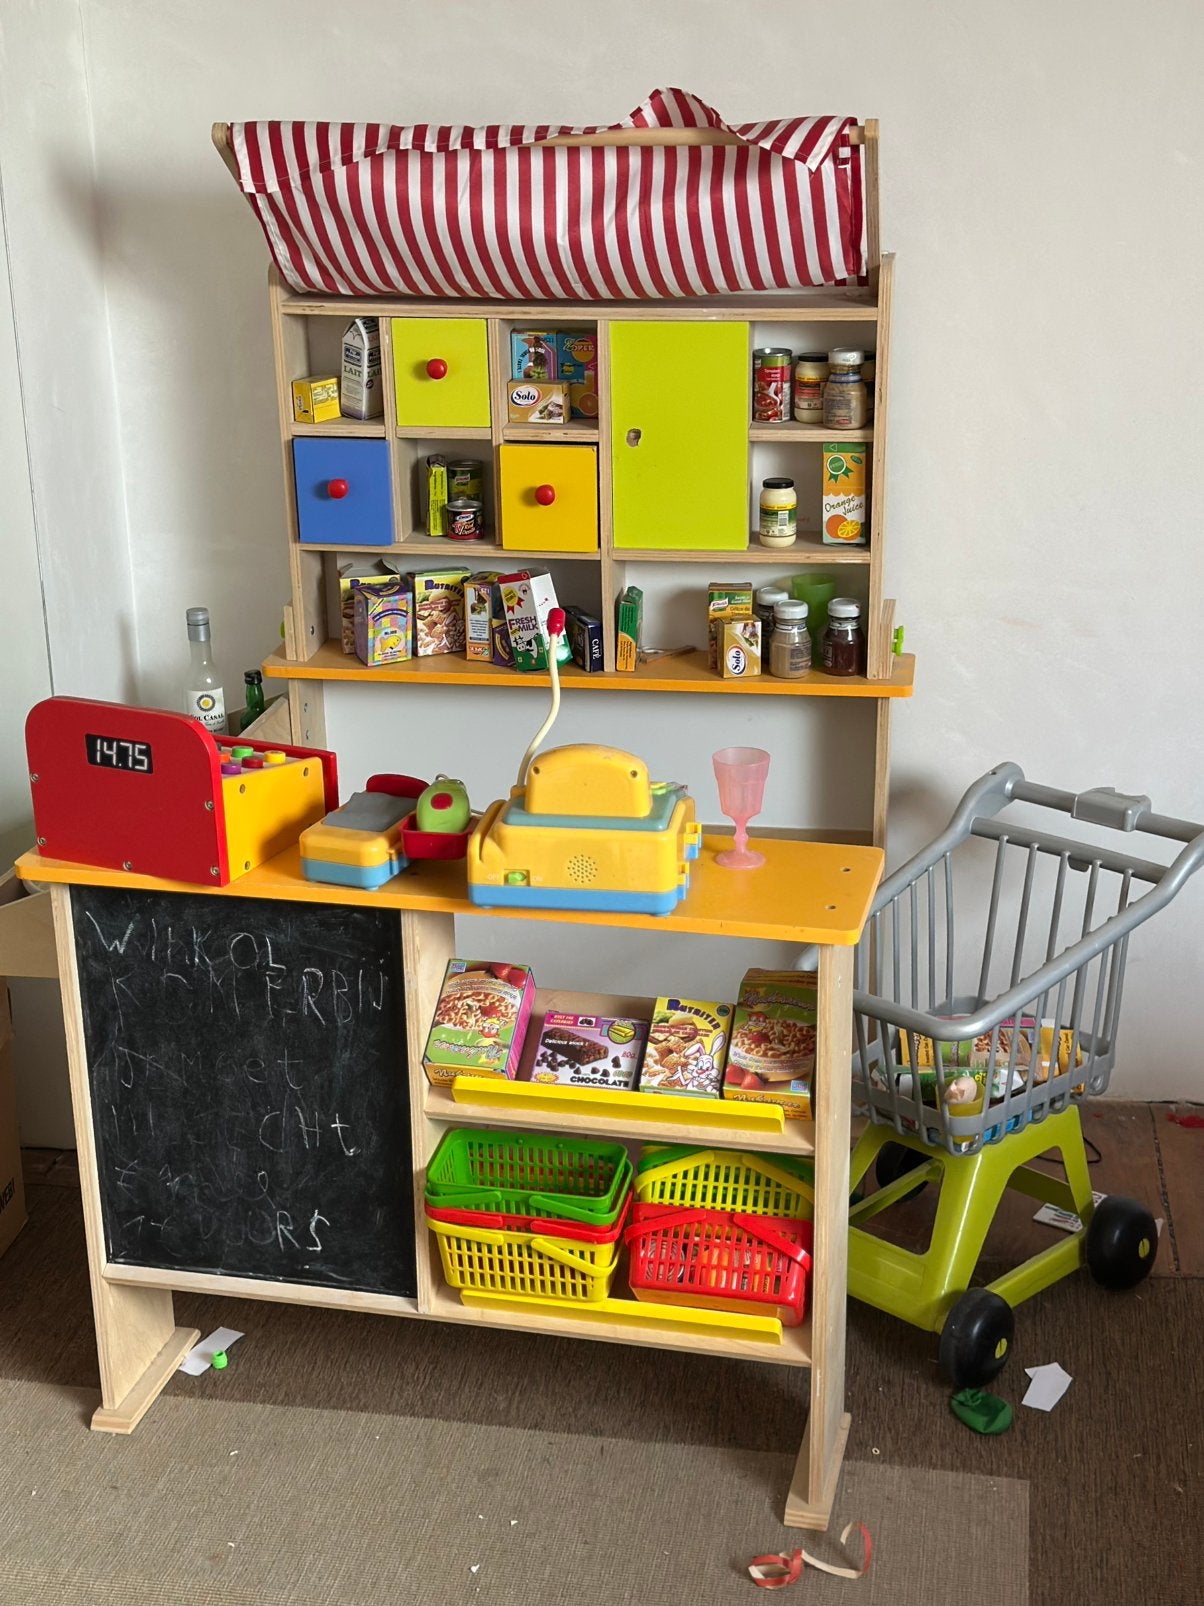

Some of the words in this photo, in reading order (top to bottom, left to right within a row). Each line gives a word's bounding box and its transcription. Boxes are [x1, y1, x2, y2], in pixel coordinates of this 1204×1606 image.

[344, 365, 362, 378] LAIT
[513, 389, 536, 401] Solo
[824, 495, 856, 513] Orange
[842, 501, 864, 516] Juice
[508, 615, 537, 631] FRESH
[518, 623, 539, 632] MILK
[732, 650, 742, 672] Solo
[96, 738, 149, 770] 14.75
[569, 1075, 630, 1089] CHOCOLATE
